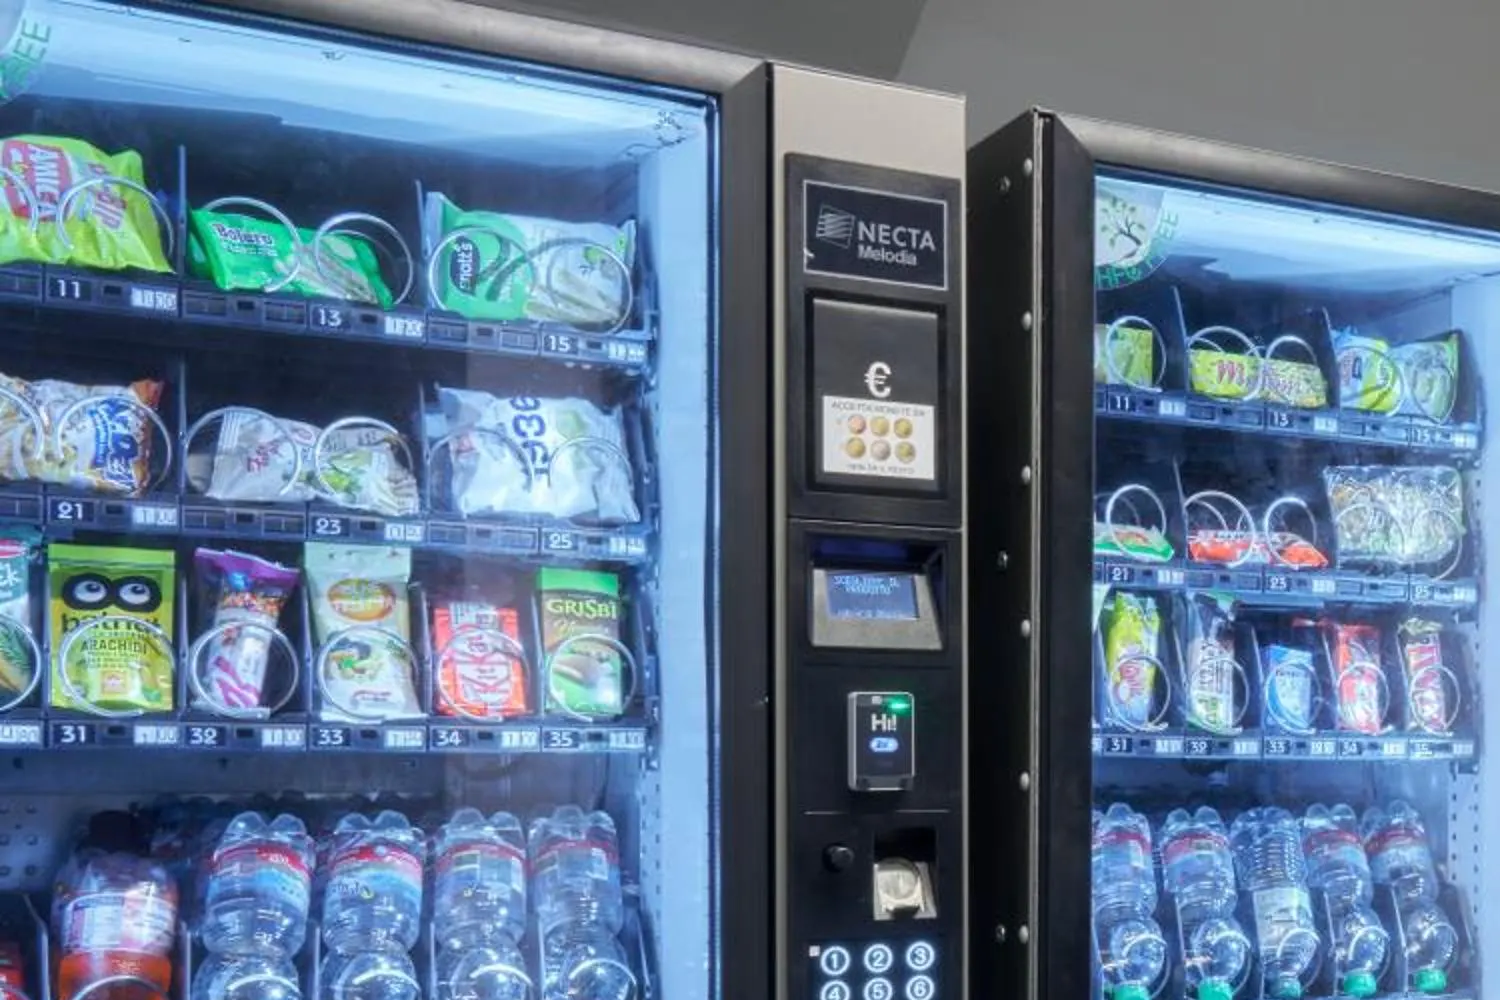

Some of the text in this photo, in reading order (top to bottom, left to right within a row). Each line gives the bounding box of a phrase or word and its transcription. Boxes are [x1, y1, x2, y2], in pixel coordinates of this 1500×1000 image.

[857, 220, 936, 251] NECTA
[858, 245, 917, 267] Melodia
[57, 279, 80, 298] 11
[318, 309, 341, 326] 13
[550, 336, 571, 351] 15
[864, 361, 892, 398] €
[57, 502, 83, 520] 21
[316, 519, 341, 534] 23
[550, 534, 571, 548] 25
[871, 713, 898, 733] Hi!
[61, 726, 87, 743] 31
[190, 727, 217, 744] 32
[319, 730, 343, 745] 33
[436, 730, 462, 745] 34
[550, 732, 572, 746] 35
